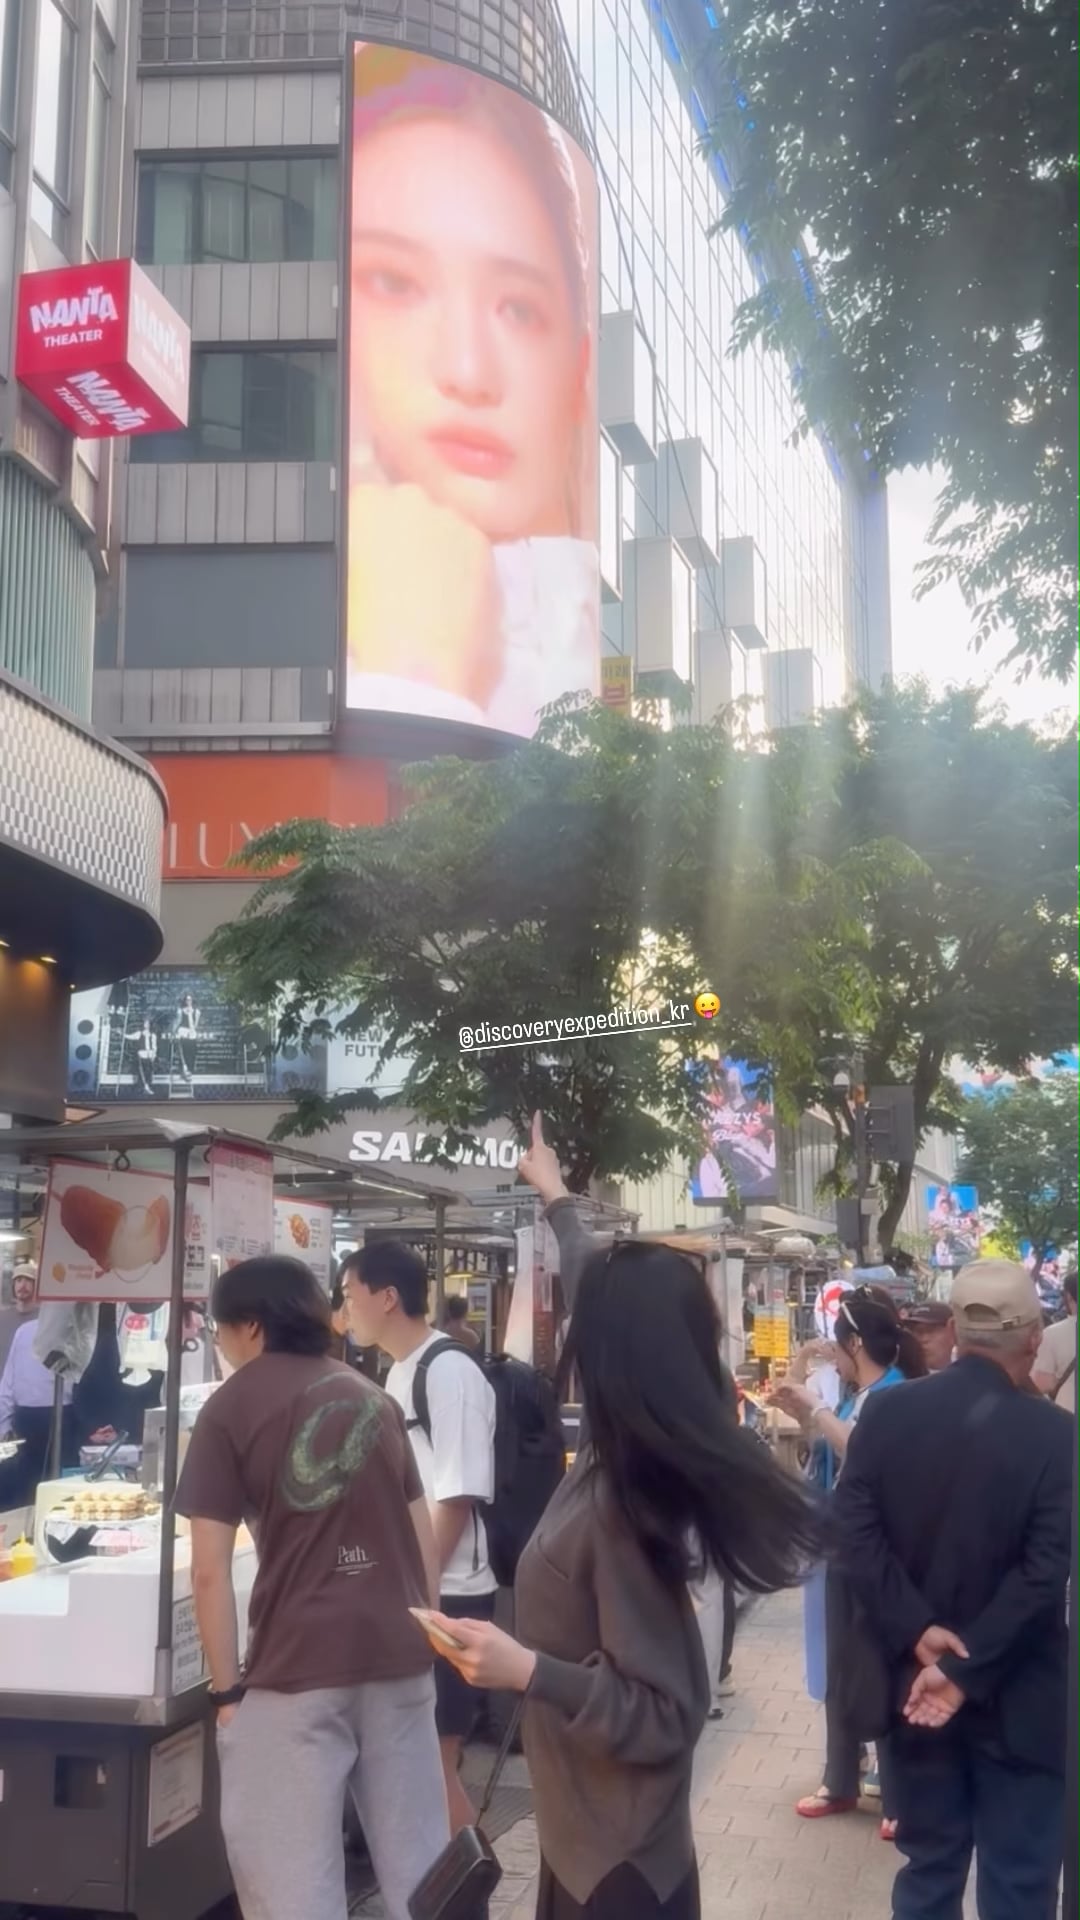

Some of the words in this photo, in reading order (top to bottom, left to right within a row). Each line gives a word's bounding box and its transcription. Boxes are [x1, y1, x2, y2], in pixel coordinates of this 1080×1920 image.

[30, 286, 118, 333] NANTA
[43, 329, 103, 348] THEATER
[54, 386, 100, 427] THEATER
[66, 370, 151, 432] NANTA
